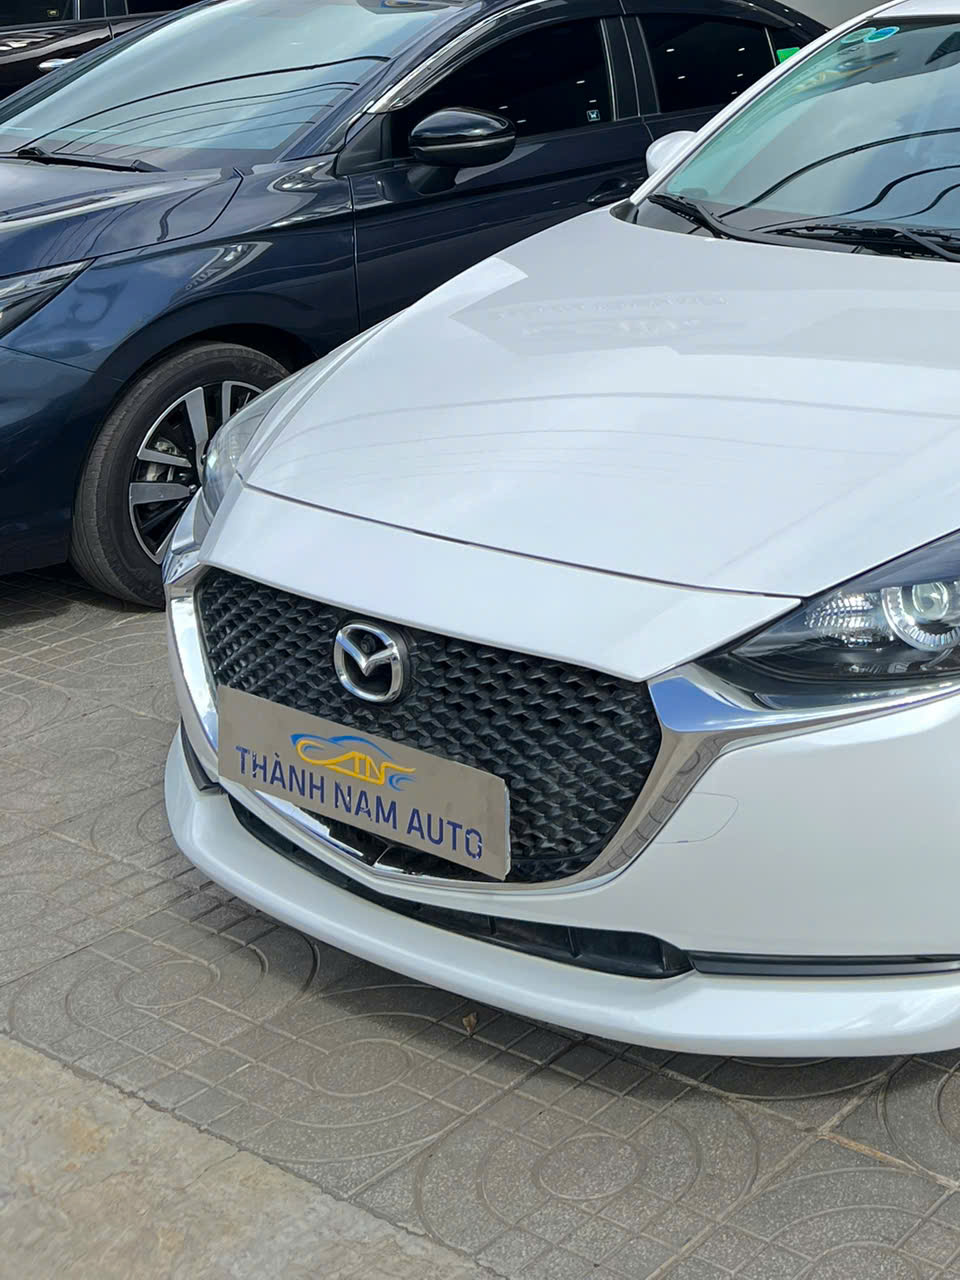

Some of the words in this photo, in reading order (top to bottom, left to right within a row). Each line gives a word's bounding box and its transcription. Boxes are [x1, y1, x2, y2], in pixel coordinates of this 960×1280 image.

[235, 745, 325, 804] THÀNH
[334, 781, 397, 830] NAM
[406, 808, 483, 860] AUTO
